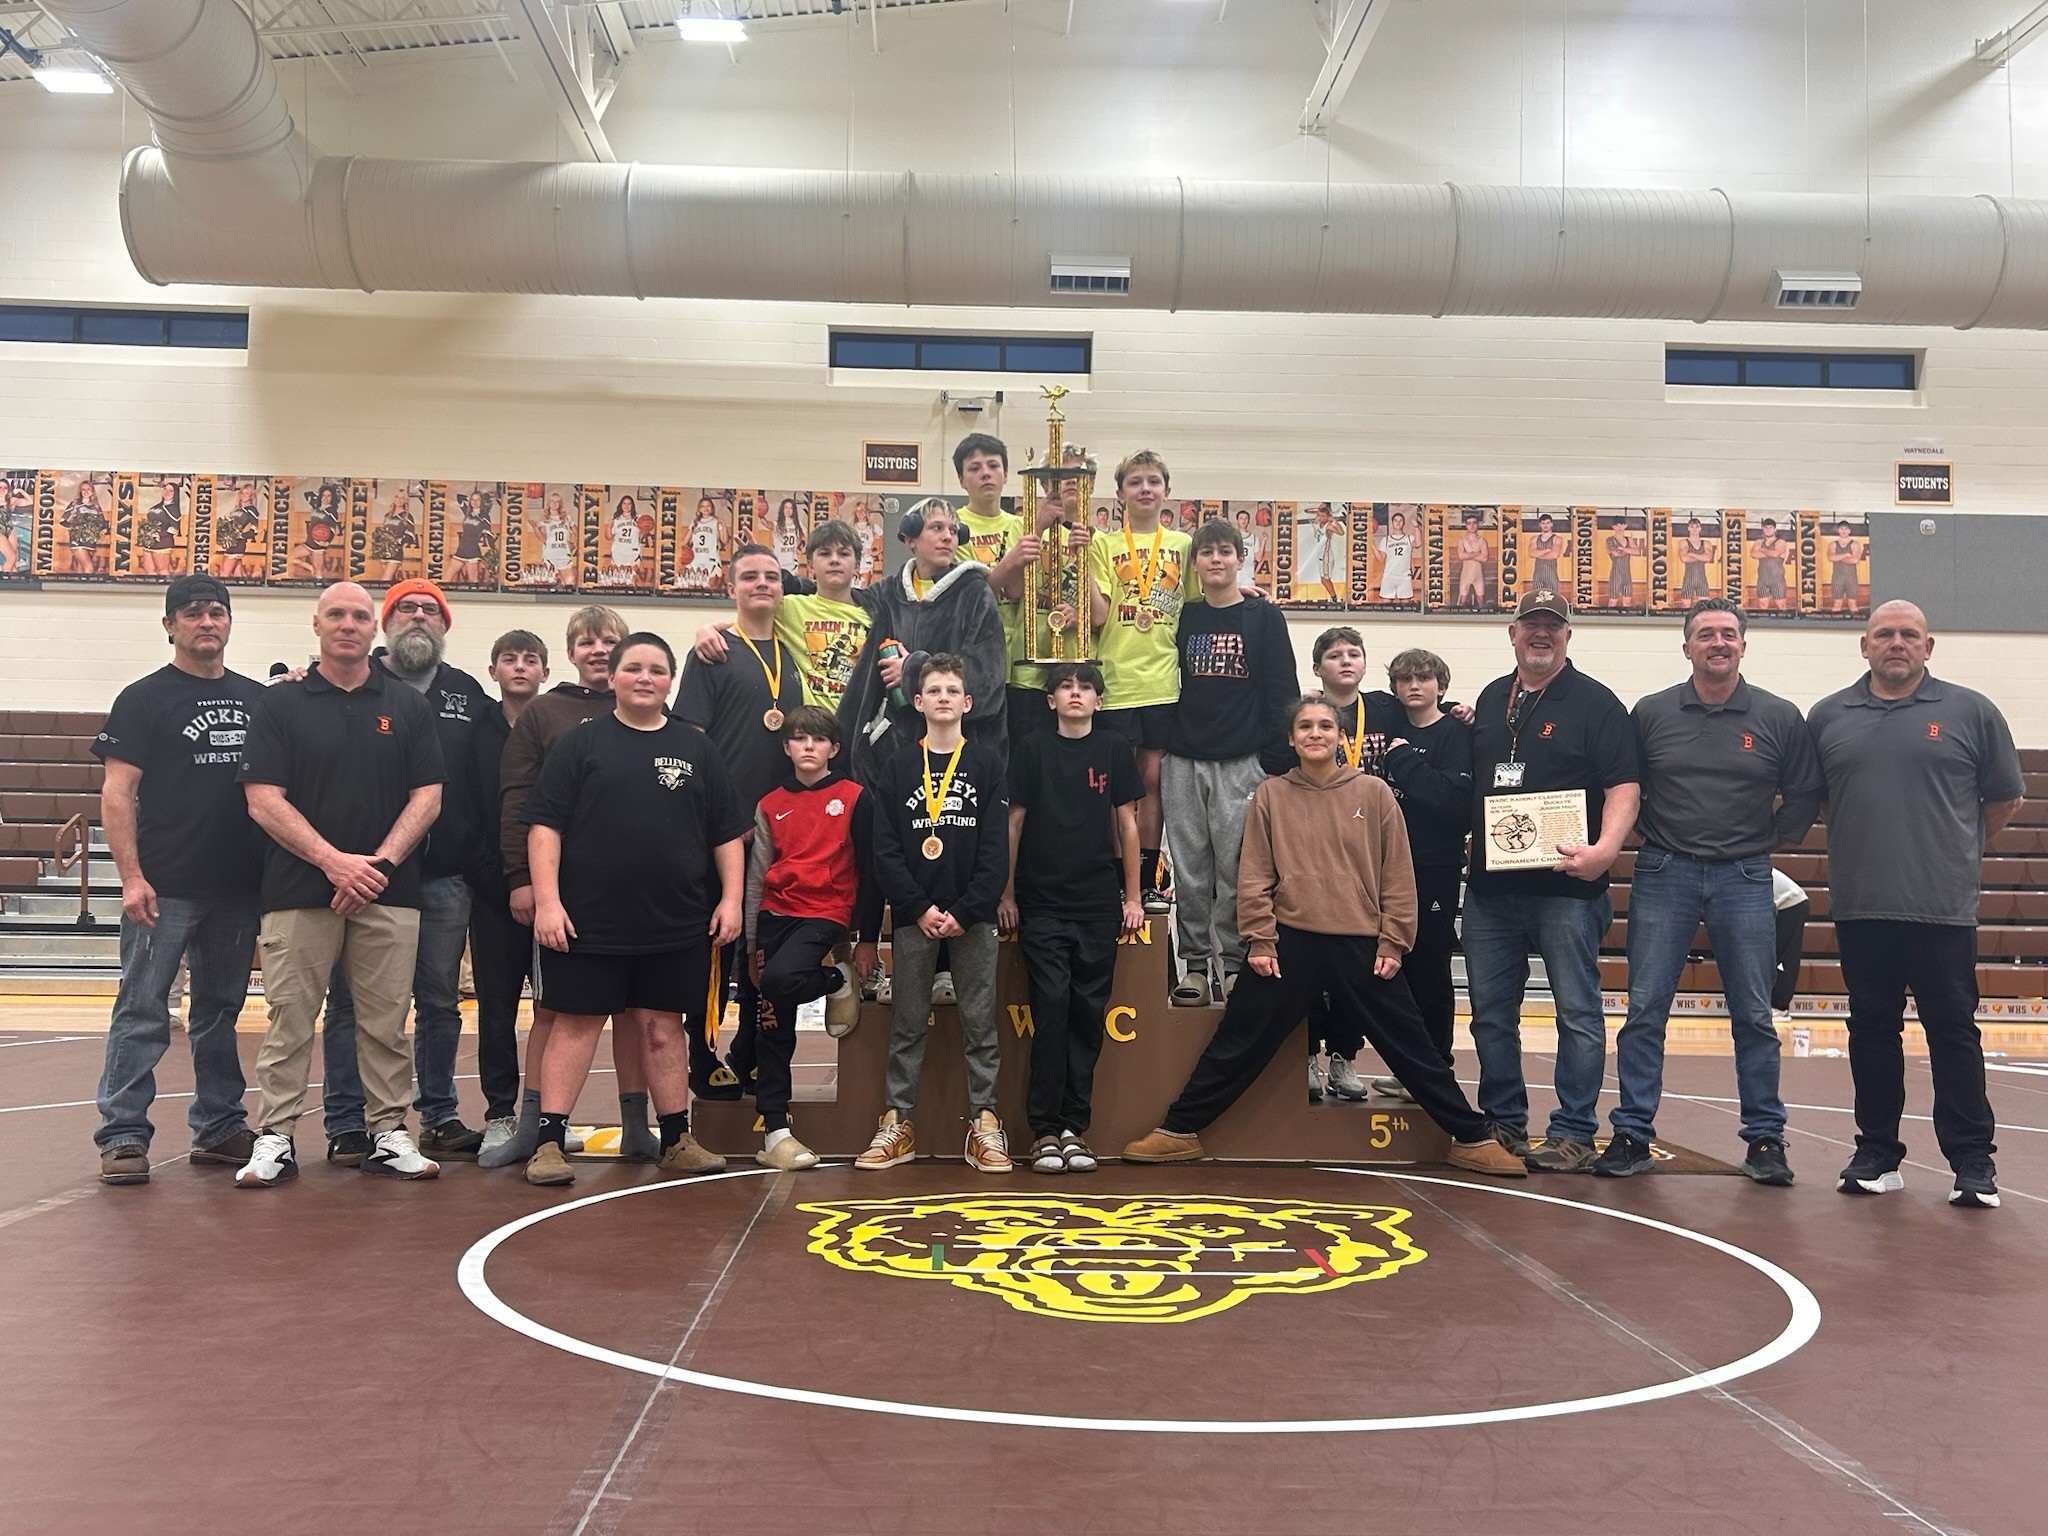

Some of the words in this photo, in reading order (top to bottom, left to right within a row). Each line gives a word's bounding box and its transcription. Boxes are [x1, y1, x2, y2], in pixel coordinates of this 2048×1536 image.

[866, 456, 917, 470] VISITORS
[1903, 447, 1944, 455] WAYNEDALE
[1899, 476, 1949, 490] STUDENTS
[37, 480, 55, 571] MADISON
[115, 481, 134, 571] MAYS
[193, 484, 212, 576] PERSINGER
[271, 485, 290, 576] WEIRICK
[350, 486, 368, 578] WOLFE
[427, 489, 446, 580] McKELVEY
[505, 491, 523, 582] COMPSTON
[554, 531, 564, 542] 10
[583, 493, 600, 584] BANEY
[621, 528, 632, 537] 21
[660, 496, 677, 586] MILLER
[699, 535, 706, 546] 3
[782, 535, 795, 546] 20
[1394, 546, 1404, 556] 12
[1277, 510, 1292, 600] BUCHER
[1351, 511, 1368, 601] SCHLABACH
[1428, 515, 1444, 604] BERNALL
[1502, 514, 1518, 603] POSEY
[1577, 515, 1592, 605] PATTERSON
[1652, 517, 1667, 606] TROYER
[1726, 518, 1742, 605] WALTERS
[1800, 520, 1817, 609] LEMON
[805, 621, 845, 633] TAKIN'
[848, 621, 861, 637] IT
[380, 718, 390, 731] B
[1542, 724, 1552, 736] B
[1929, 724, 1939, 737] B
[1743, 735, 1753, 748] B
[653, 757, 694, 774] BELLEVUE
[1491, 857, 1539, 866] TOURNAMENT
[1676, 999, 1696, 1009] WHS
[1794, 1001, 1814, 1011] WHS
[2007, 1004, 2027, 1014] WHS
[1370, 1114, 1410, 1149] 5th
